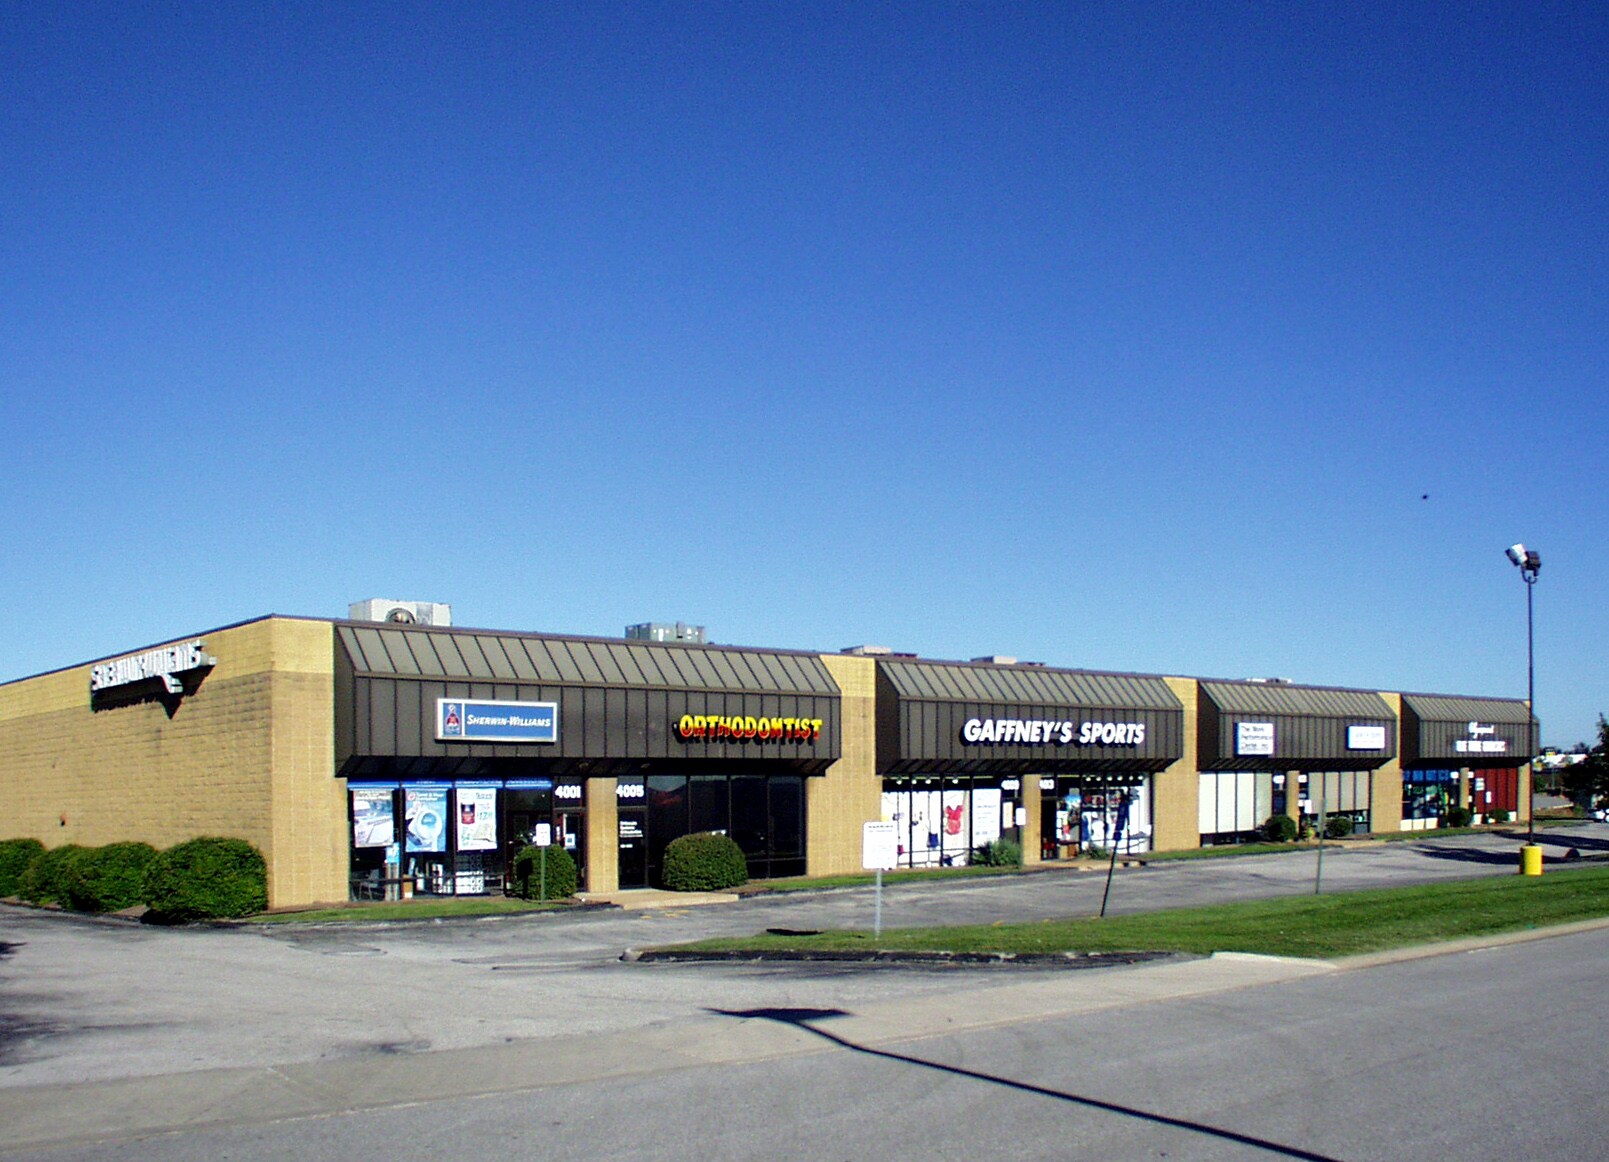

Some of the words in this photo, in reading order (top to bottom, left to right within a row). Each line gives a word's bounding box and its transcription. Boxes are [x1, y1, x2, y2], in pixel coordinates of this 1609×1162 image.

[679, 714, 823, 740] ORTHODONTIST
[963, 718, 1073, 743] GAFFNEY'S
[1079, 721, 1146, 745] SPORTS
[554, 785, 581, 799] 4001
[615, 784, 645, 798] 4005
